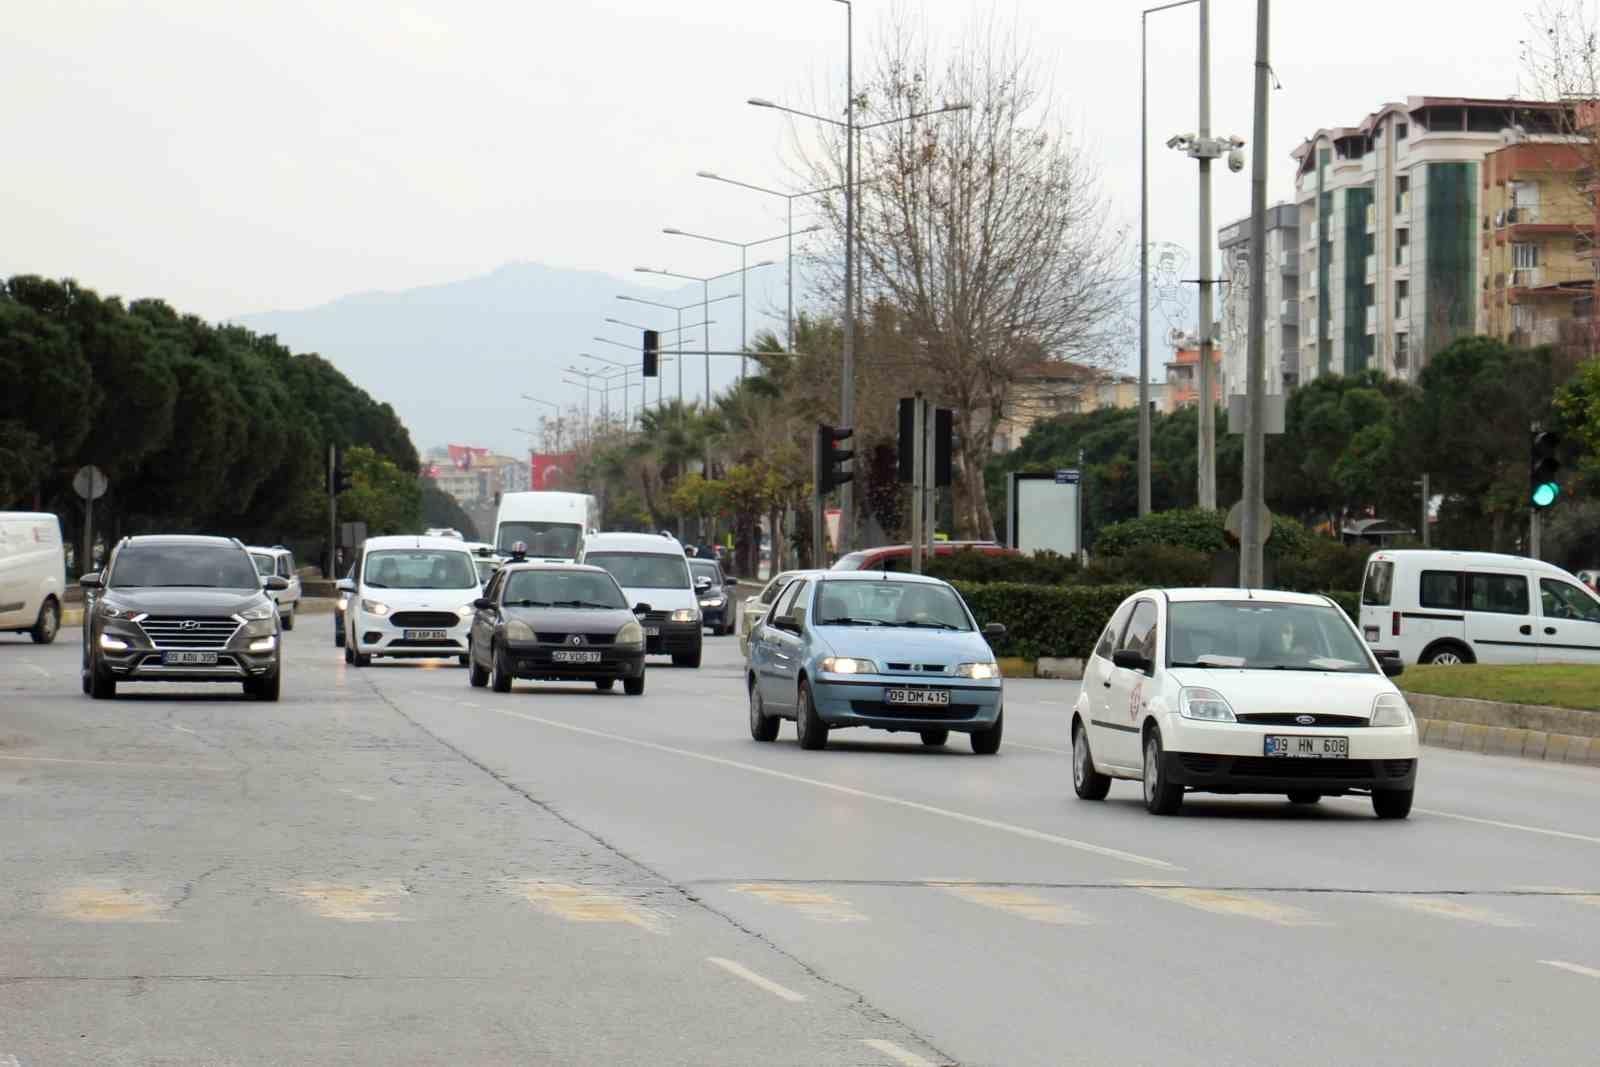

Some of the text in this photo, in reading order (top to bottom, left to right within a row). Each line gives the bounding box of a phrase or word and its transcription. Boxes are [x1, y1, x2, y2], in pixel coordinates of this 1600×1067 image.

[890, 690, 948, 703] 09 DM 415
[1273, 738, 1346, 753] 09 HN 608
